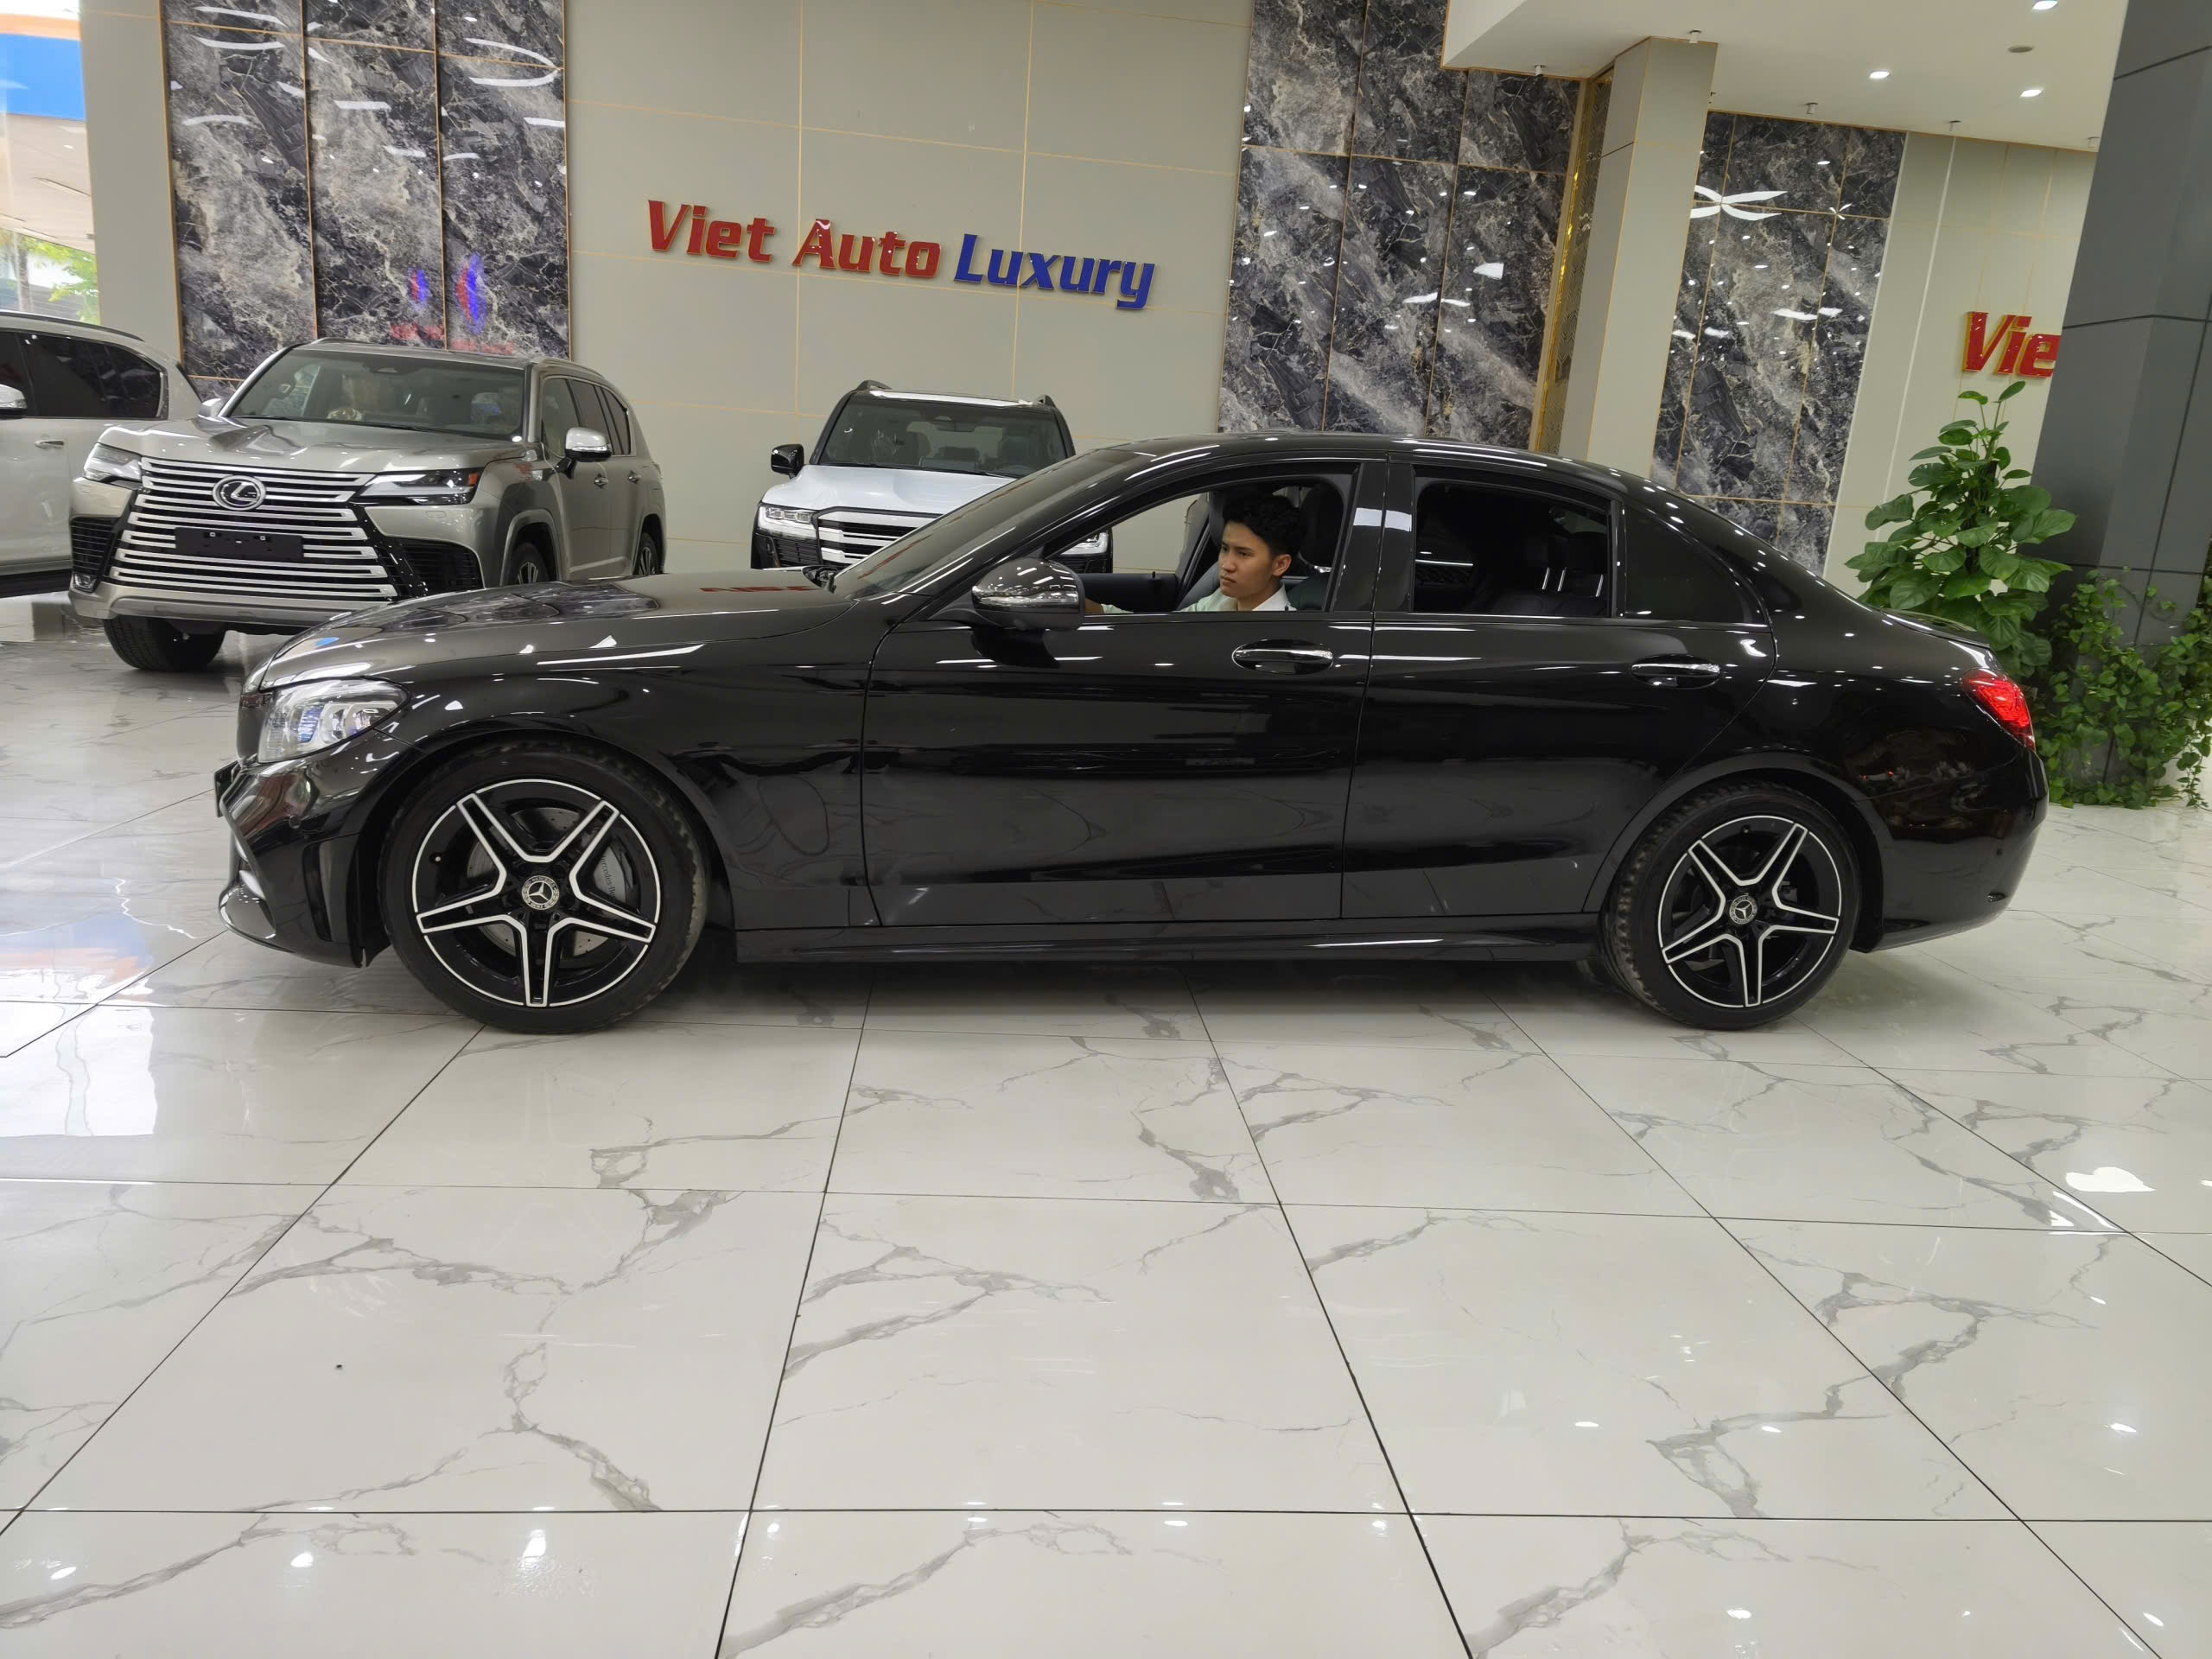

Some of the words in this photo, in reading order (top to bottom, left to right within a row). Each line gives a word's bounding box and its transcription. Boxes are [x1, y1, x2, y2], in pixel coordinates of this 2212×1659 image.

[647, 200, 776, 264] Viet
[791, 218, 943, 279] Auto
[953, 233, 1156, 310] Luxury
[1963, 311, 2063, 378] Vie
